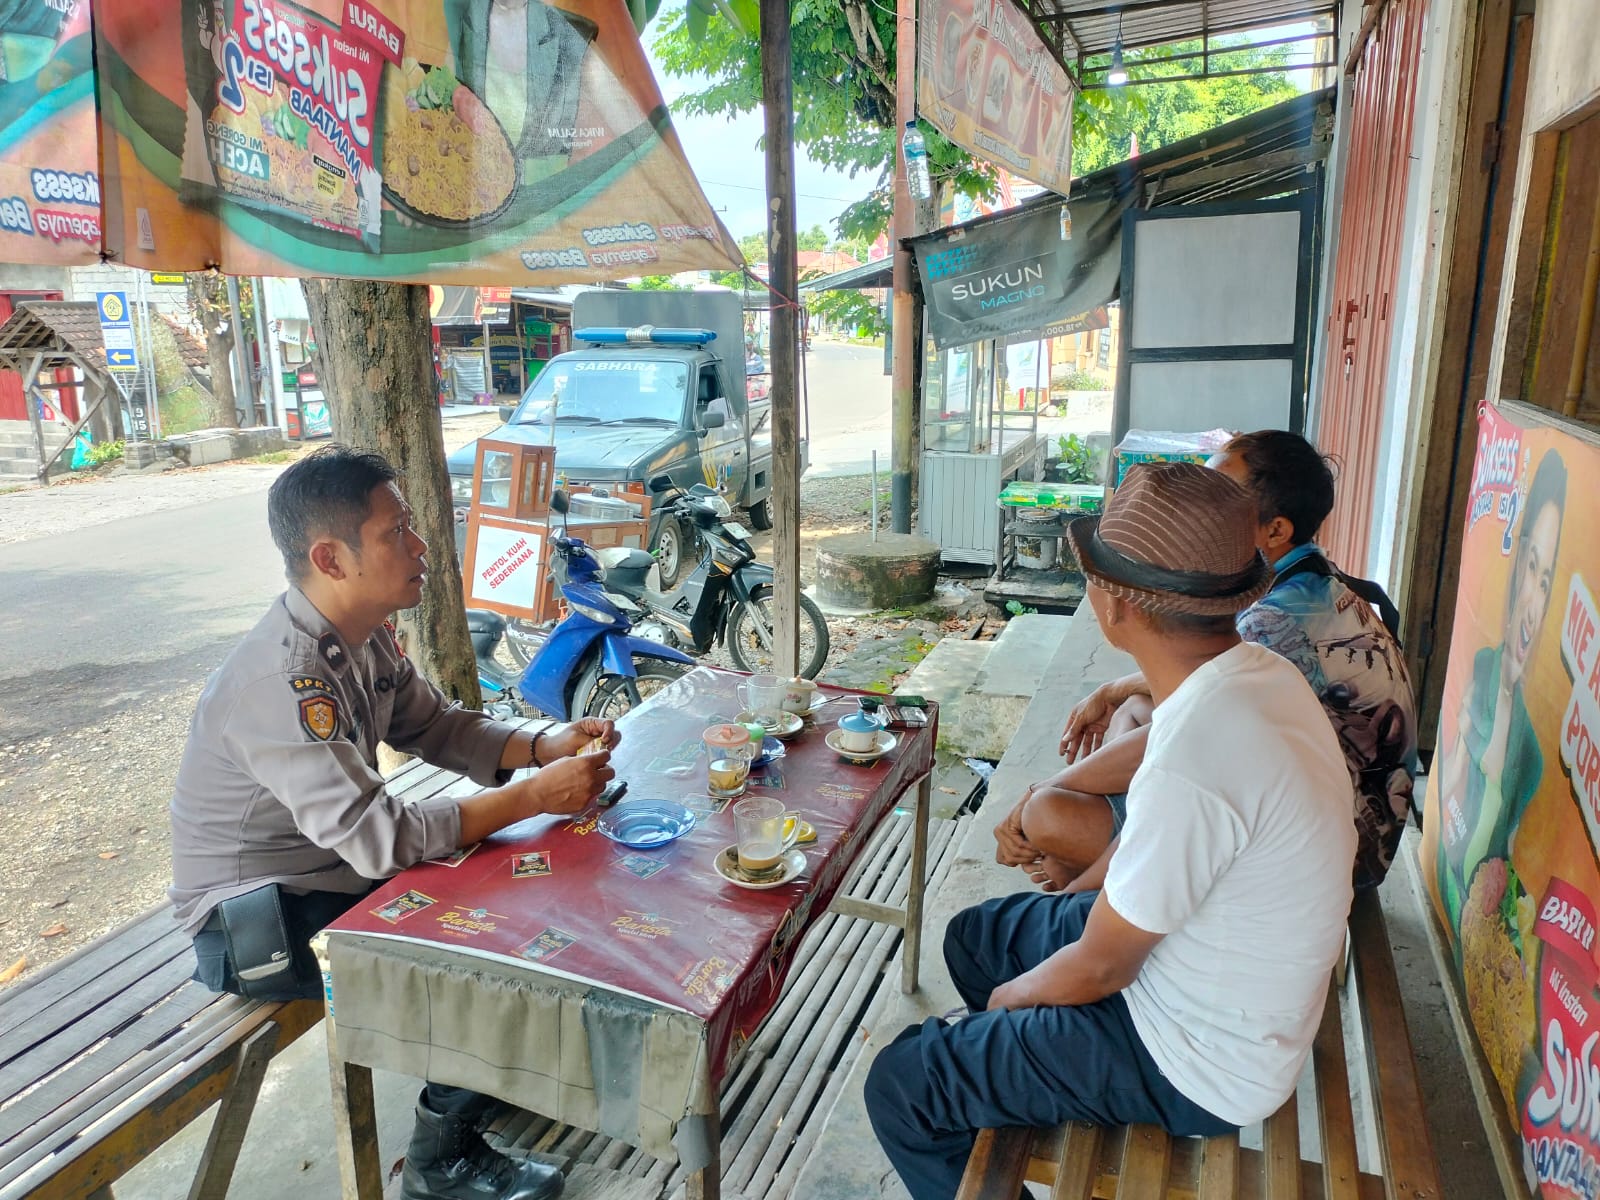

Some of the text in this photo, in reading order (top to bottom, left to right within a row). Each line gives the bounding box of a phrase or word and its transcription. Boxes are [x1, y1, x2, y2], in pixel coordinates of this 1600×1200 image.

[951, 263, 1043, 301] SUKUN
[979, 284, 1046, 311] MAGNO
[574, 361, 657, 373] SABHARA
[481, 537, 528, 581] PENTOL KUAH
[489, 547, 535, 590] SEDERHANA
[1568, 591, 1594, 674] MIE
[436, 911, 497, 933] Barista
[610, 916, 672, 936] Barista
[1548, 966, 1588, 1028] Mi Instan
